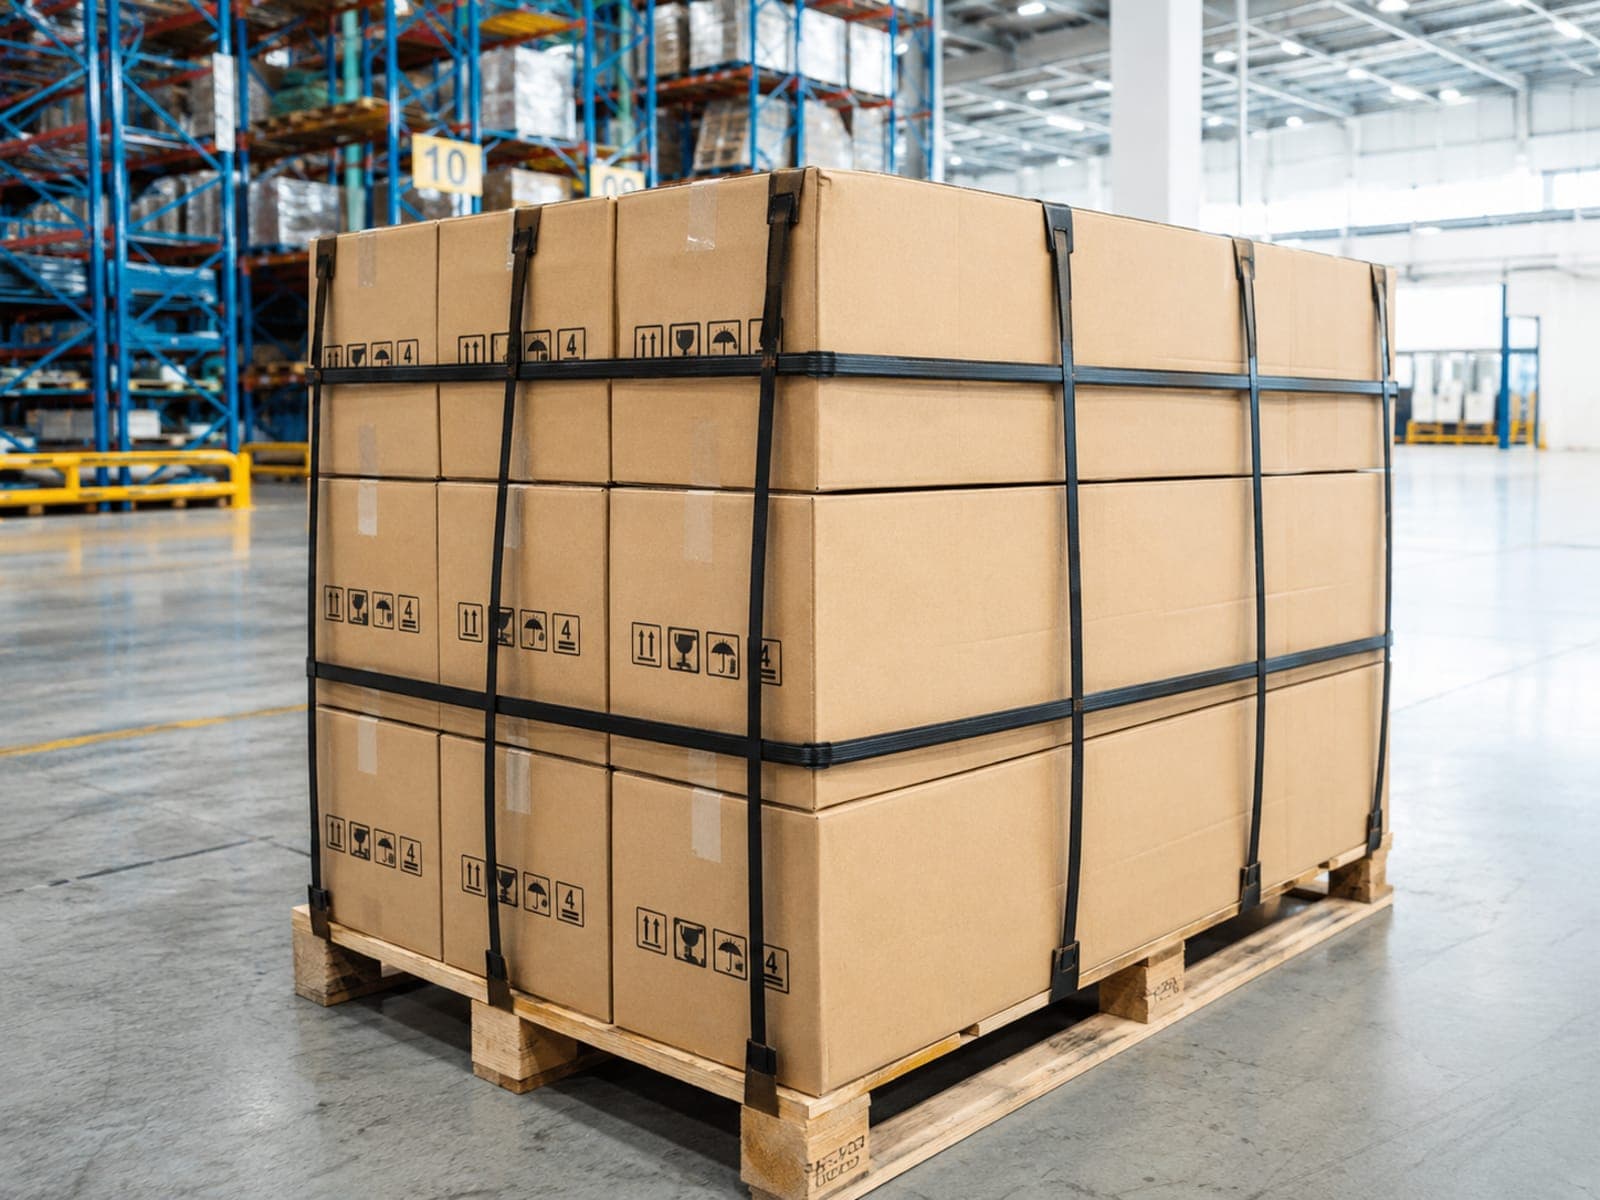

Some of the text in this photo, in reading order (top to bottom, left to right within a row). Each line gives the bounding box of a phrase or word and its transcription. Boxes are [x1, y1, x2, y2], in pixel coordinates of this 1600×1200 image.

[424, 144, 467, 185] 10
[404, 344, 412, 363] 4
[567, 334, 576, 355] 4
[405, 600, 413, 618] 4
[561, 620, 571, 639] 4
[761, 645, 770, 667] 4
[406, 843, 415, 862] 4
[565, 889, 575, 909] 4
[765, 951, 778, 974] 4
